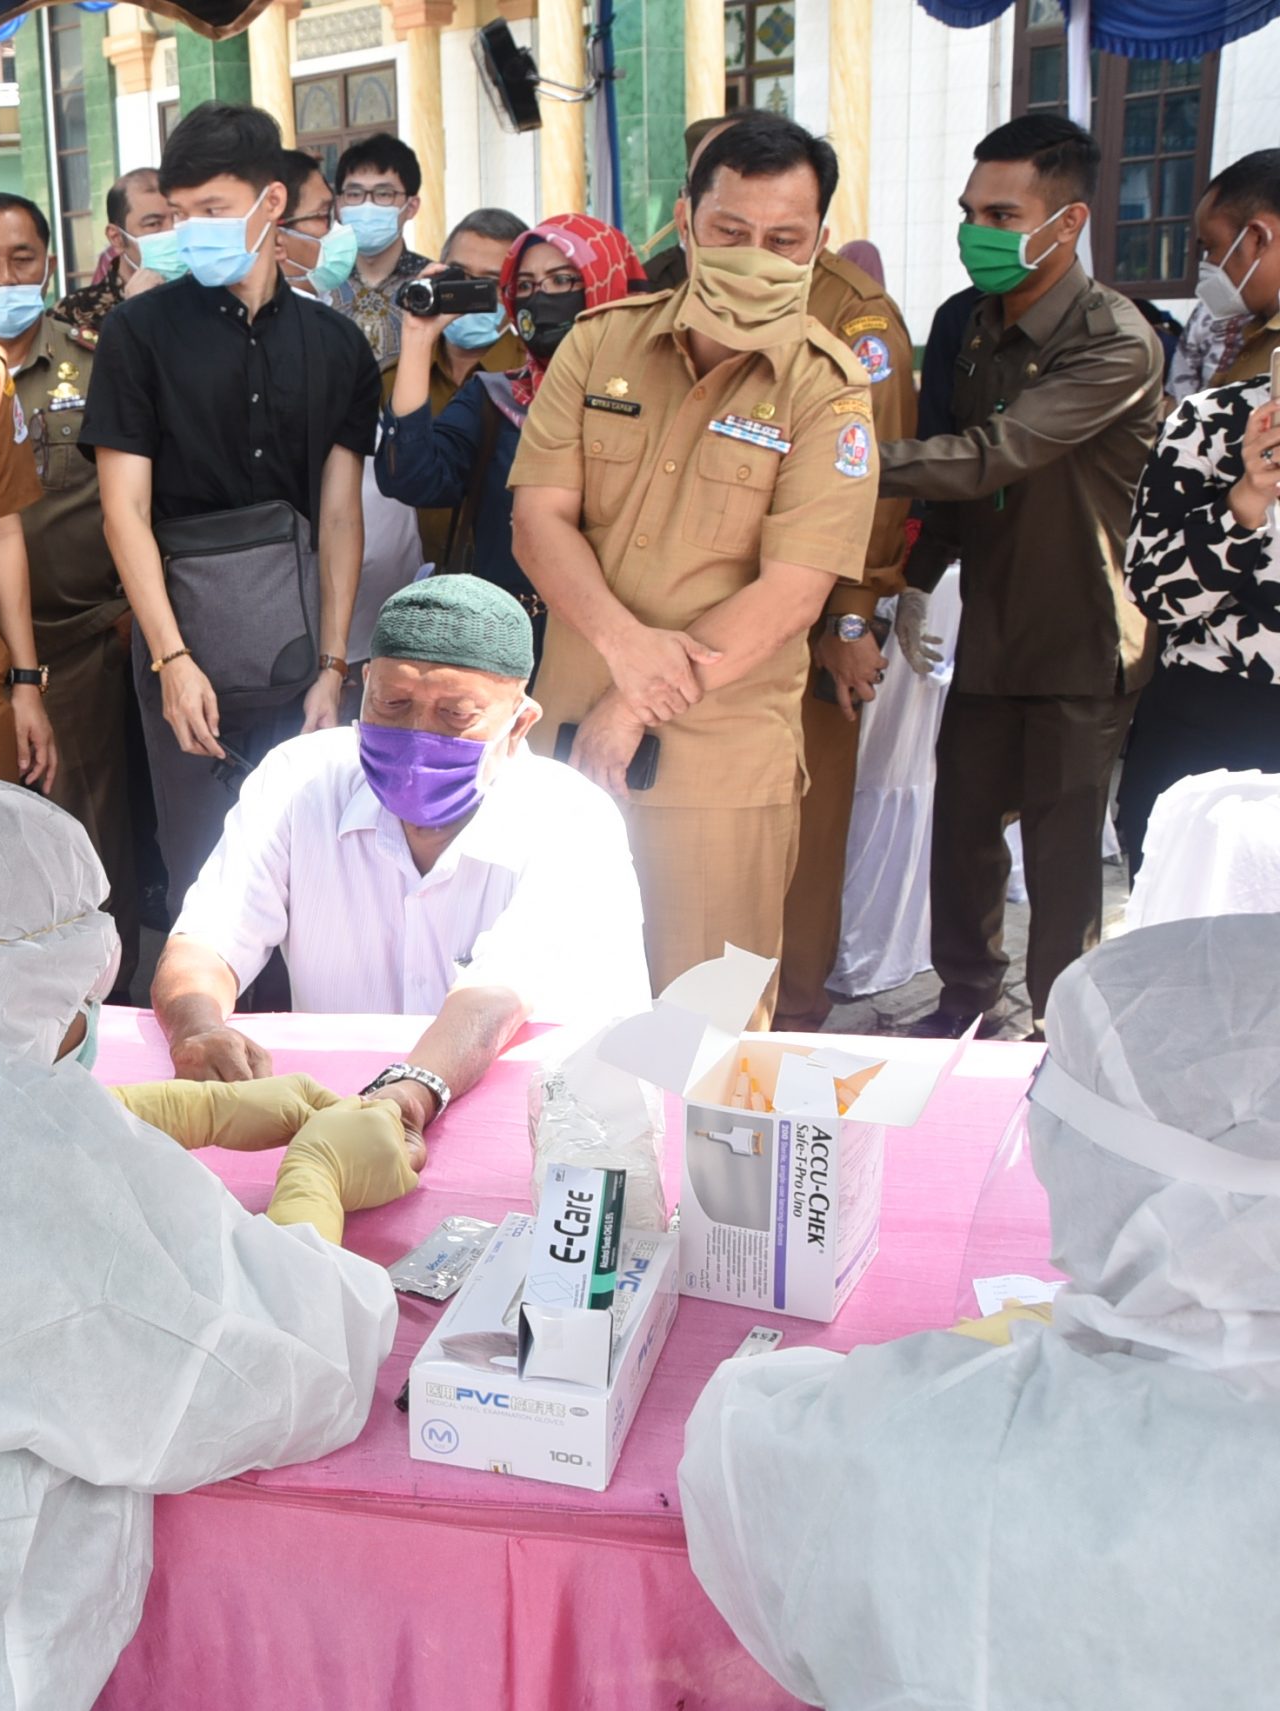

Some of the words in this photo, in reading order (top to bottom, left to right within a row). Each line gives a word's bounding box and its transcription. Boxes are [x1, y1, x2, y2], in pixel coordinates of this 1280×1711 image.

[793, 1123, 809, 1189] Safe-T-Pro
[807, 1125, 832, 1248] ACCU-CHEK
[793, 1191, 806, 1218] Uno
[456, 1387, 510, 1408] PVC
[428, 1427, 453, 1443] M
[549, 1450, 583, 1466] 100
